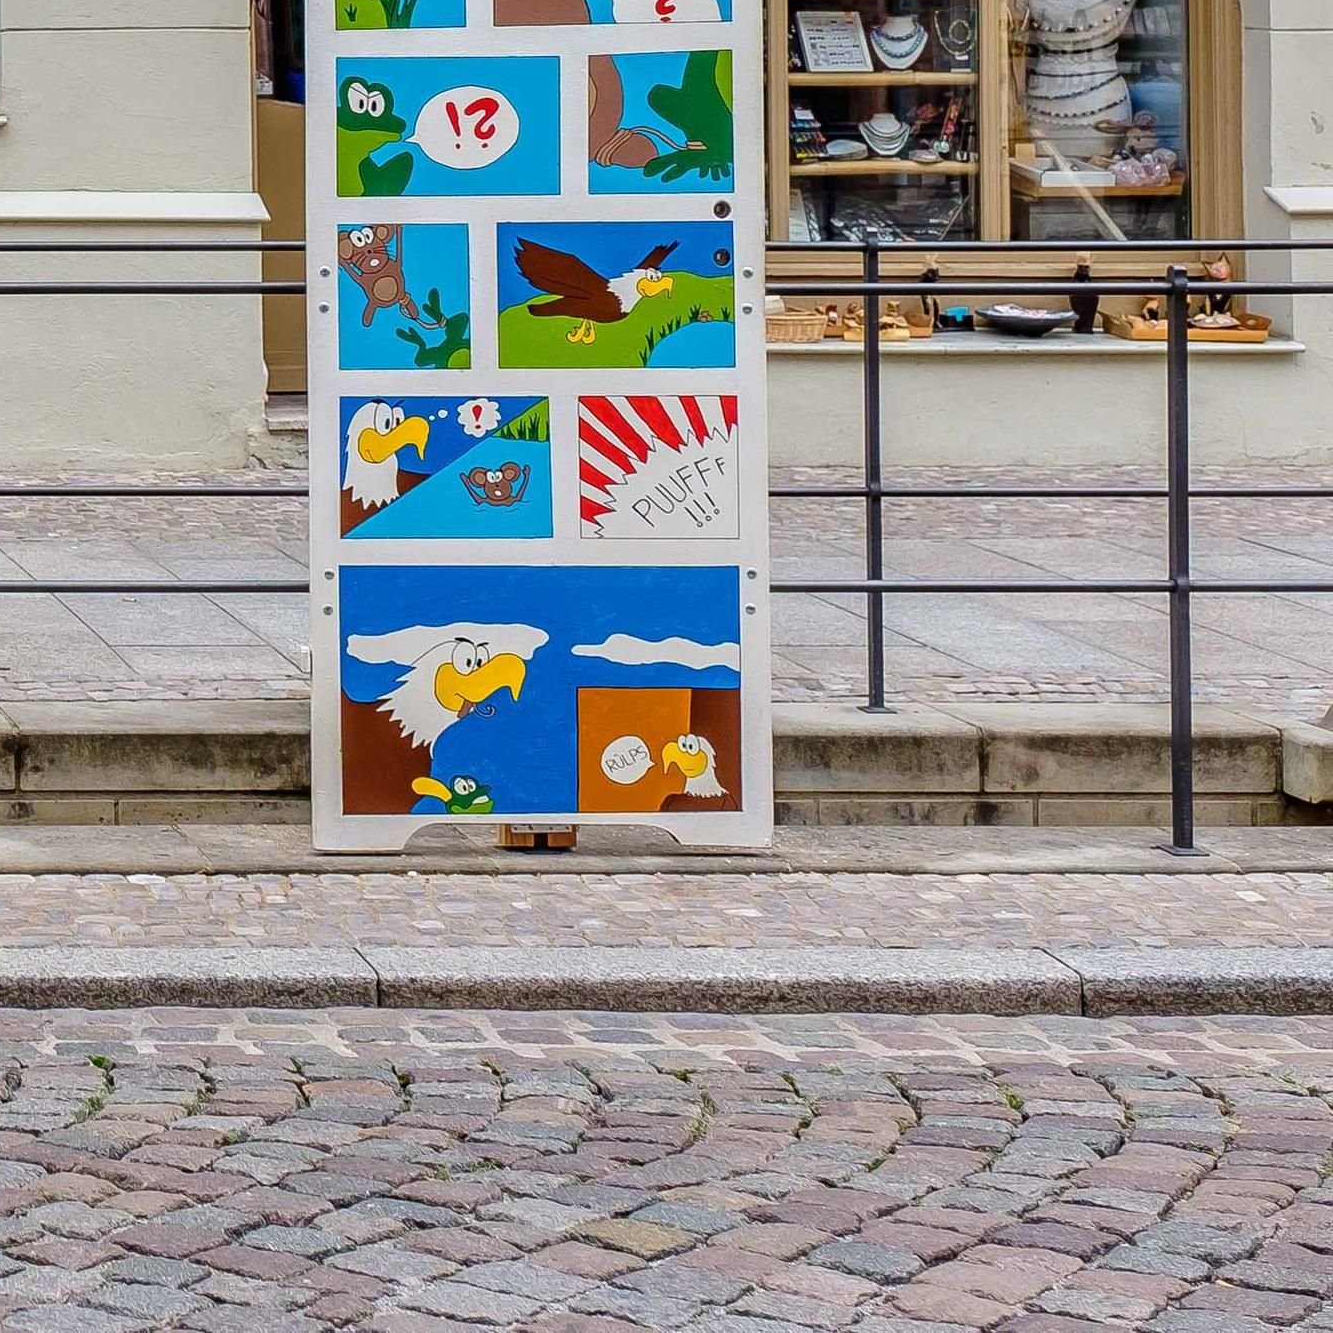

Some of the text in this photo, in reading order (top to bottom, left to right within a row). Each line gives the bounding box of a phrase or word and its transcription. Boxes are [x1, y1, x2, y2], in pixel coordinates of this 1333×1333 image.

[445, 98, 501, 150] !?
[471, 403, 483, 430] !
[632, 457, 725, 527] PUUFFF
[684, 492, 720, 527] !!!
[605, 744, 649, 773] RÜLPS
